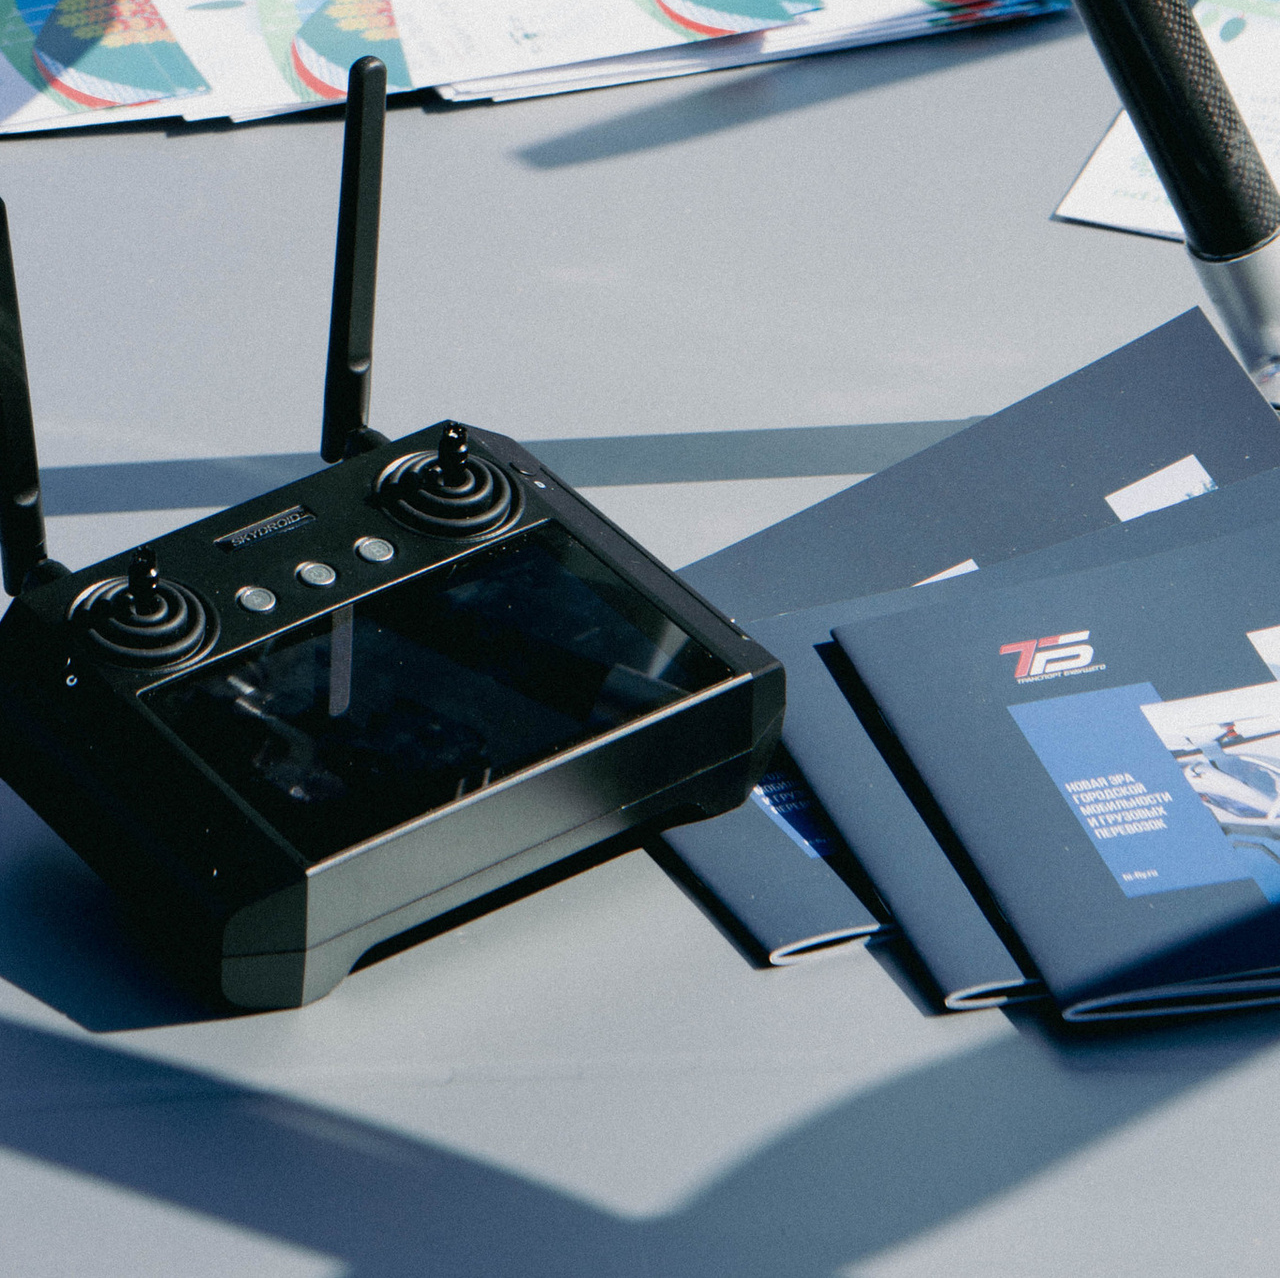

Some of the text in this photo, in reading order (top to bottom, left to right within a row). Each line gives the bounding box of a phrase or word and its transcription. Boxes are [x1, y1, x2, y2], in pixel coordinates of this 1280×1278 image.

[230, 512, 301, 547] SKYDROID
[1064, 772, 1136, 793] НОВАЯ ЭРА
[1072, 782, 1148, 805] ГОРОДСКОЙ
[1079, 791, 1174, 817] МОБИЛЬНОСТИ
[1086, 804, 1168, 829] И ГРУЗОВЫХ
[1094, 817, 1169, 840] ПЕРЕВОЗОК
